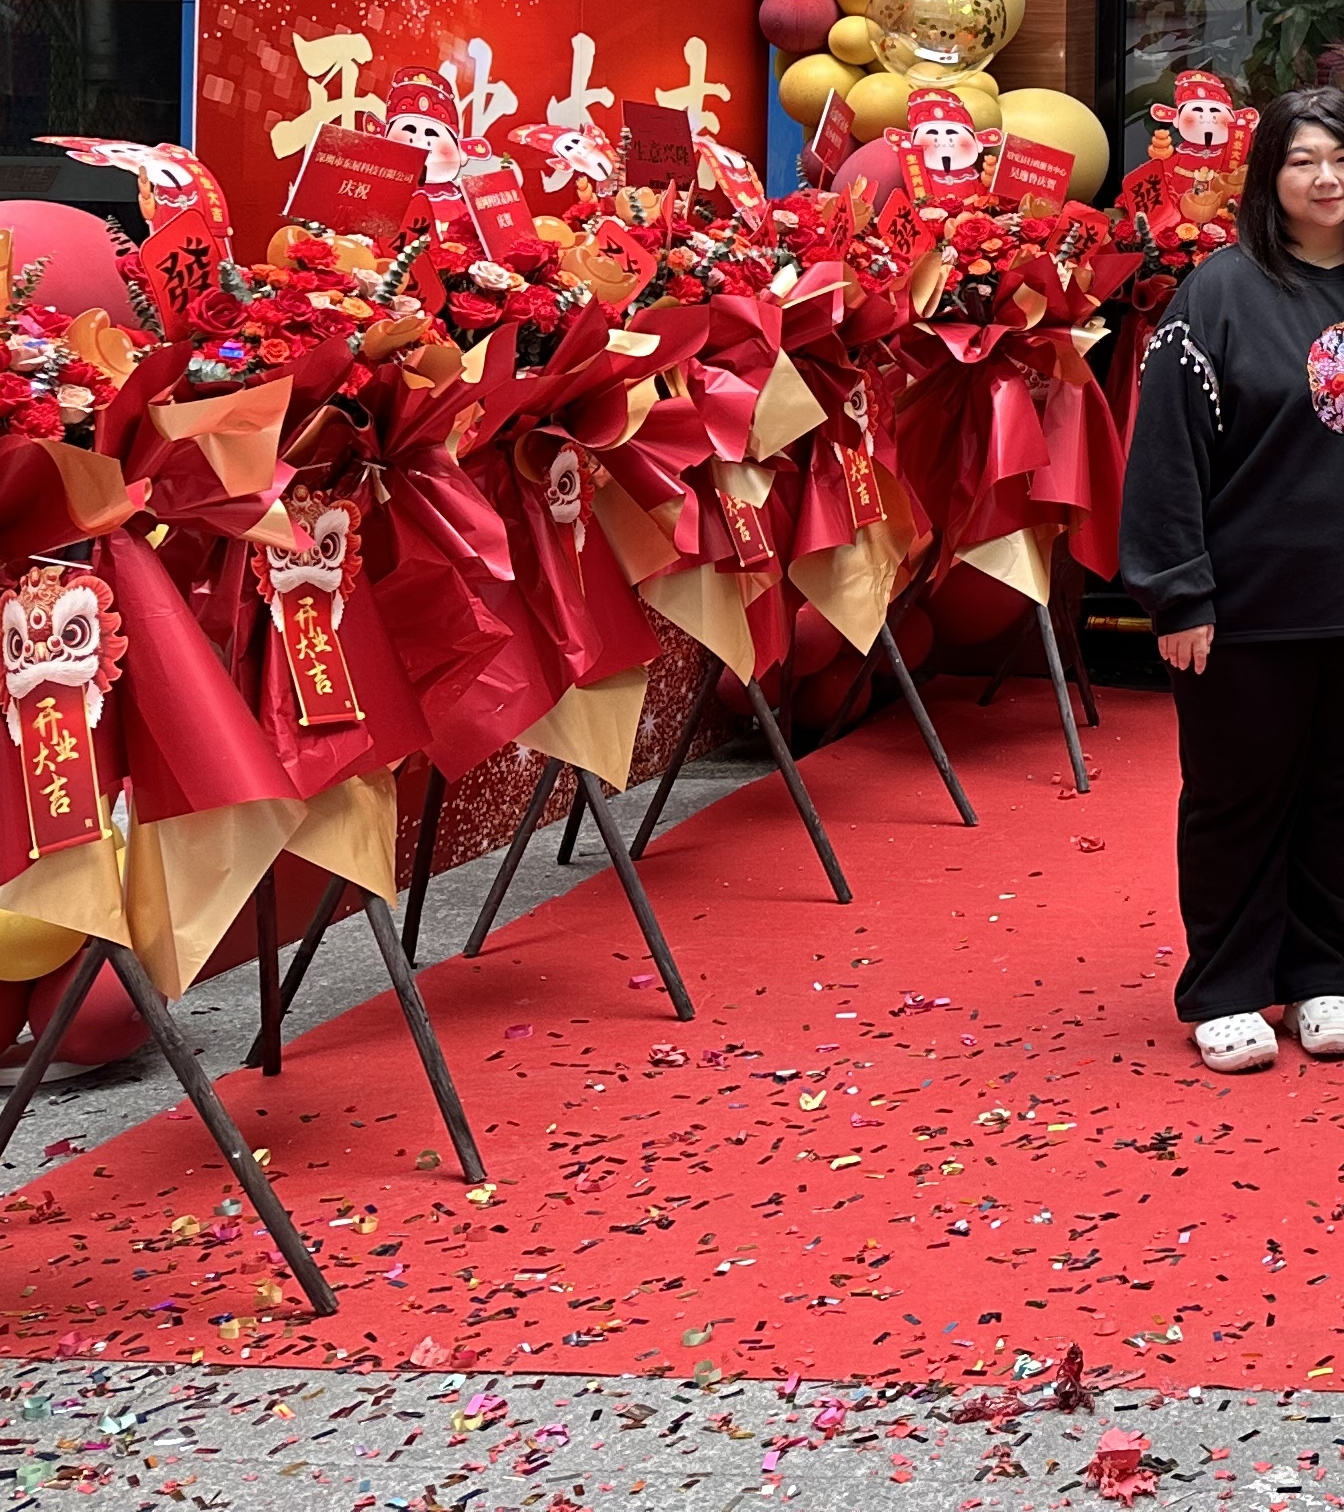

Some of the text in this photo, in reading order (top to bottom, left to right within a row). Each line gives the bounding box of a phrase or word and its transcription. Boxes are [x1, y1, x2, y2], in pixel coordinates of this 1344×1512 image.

[338, 179, 371, 200] 庆祝
[293, 597, 333, 696] 开业大吉
[32, 696, 80, 819] 开业大吉
